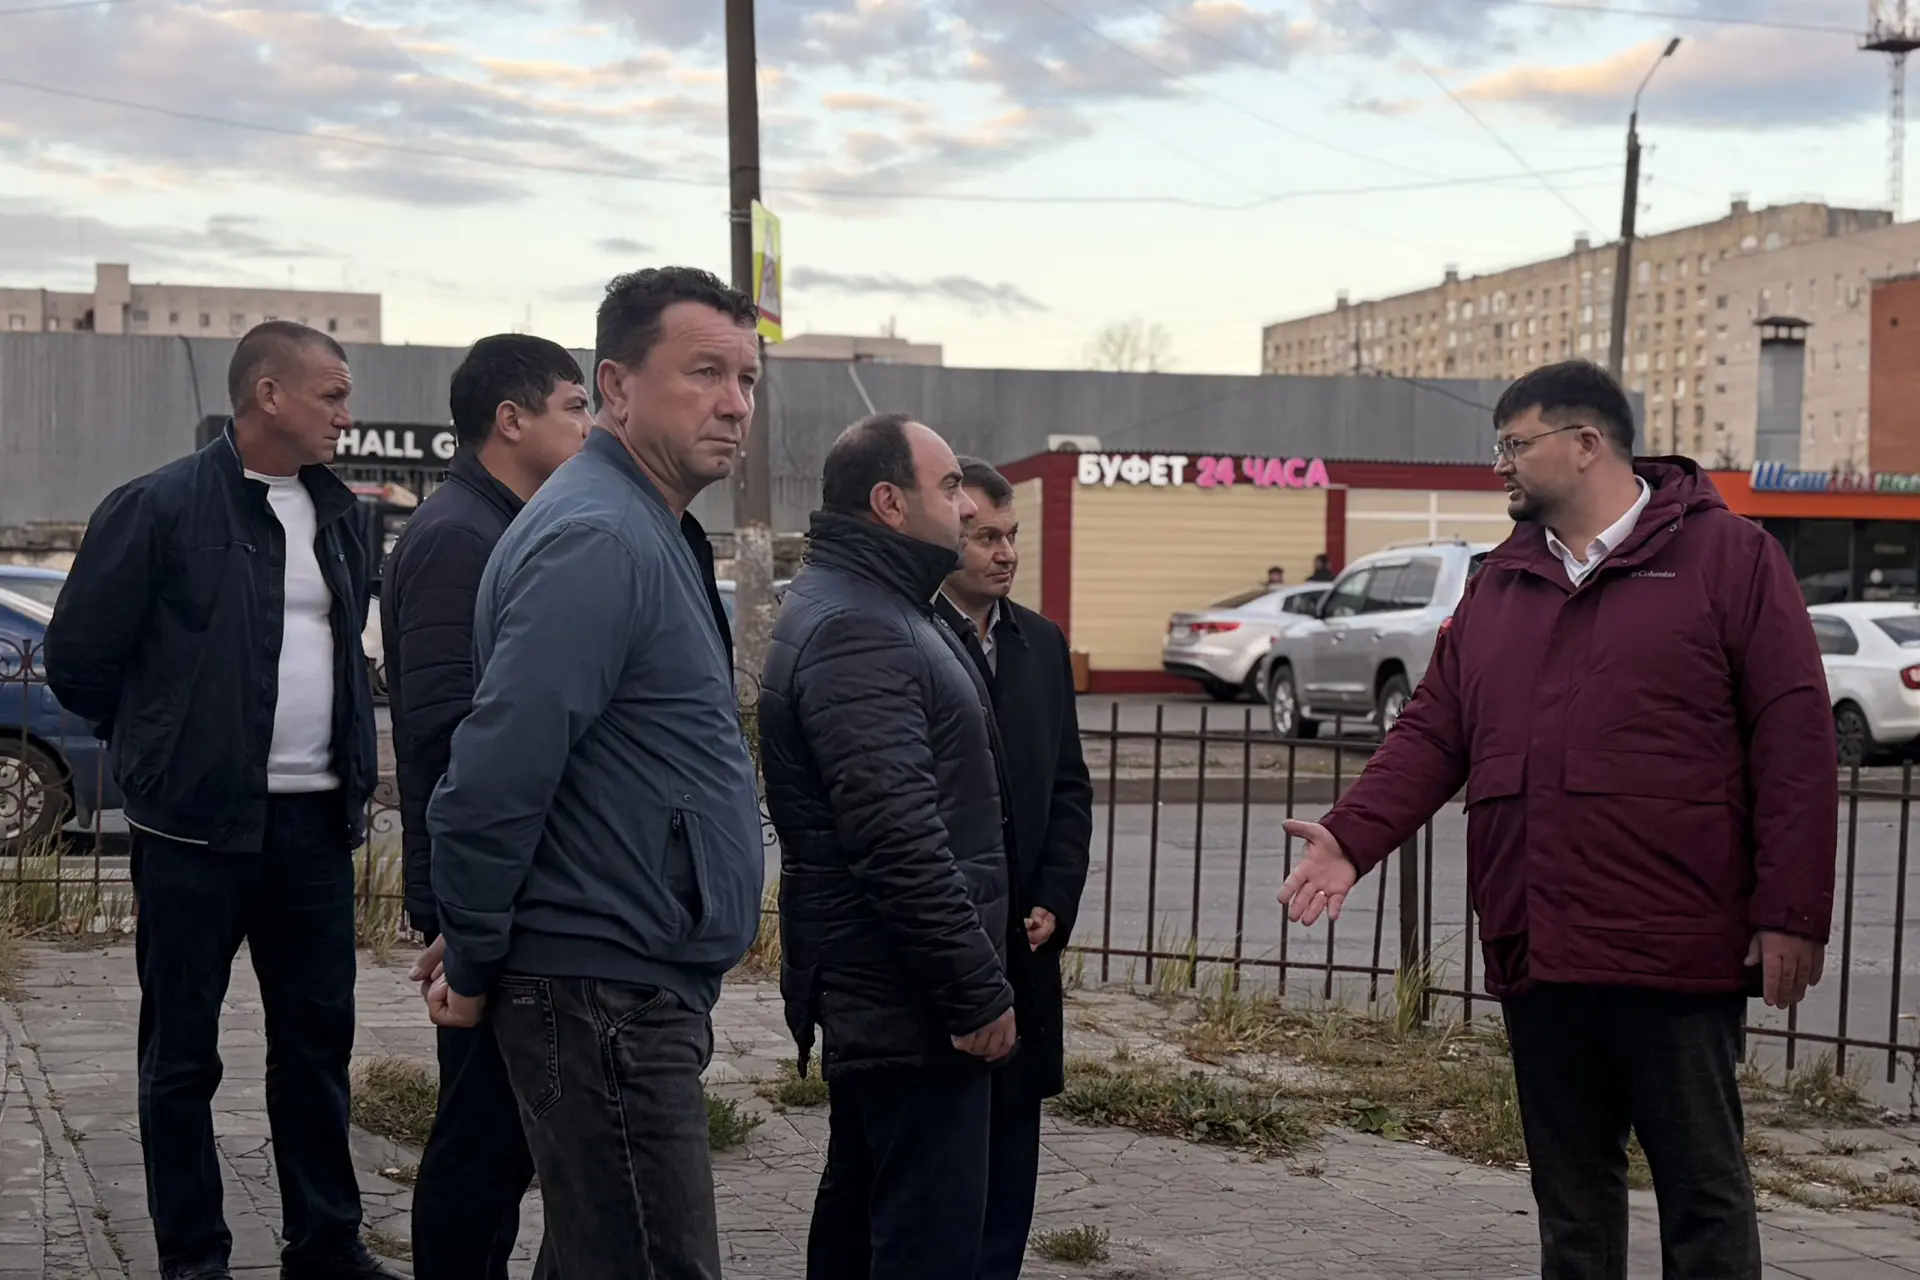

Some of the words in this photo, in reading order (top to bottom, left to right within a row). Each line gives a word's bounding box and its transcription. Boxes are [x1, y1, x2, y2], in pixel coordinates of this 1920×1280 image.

[336, 428, 424, 459] HALL
[1077, 454, 1189, 487] БУФЕТ
[1195, 456, 1236, 488] 24
[1242, 457, 1330, 488] ЧАСА
